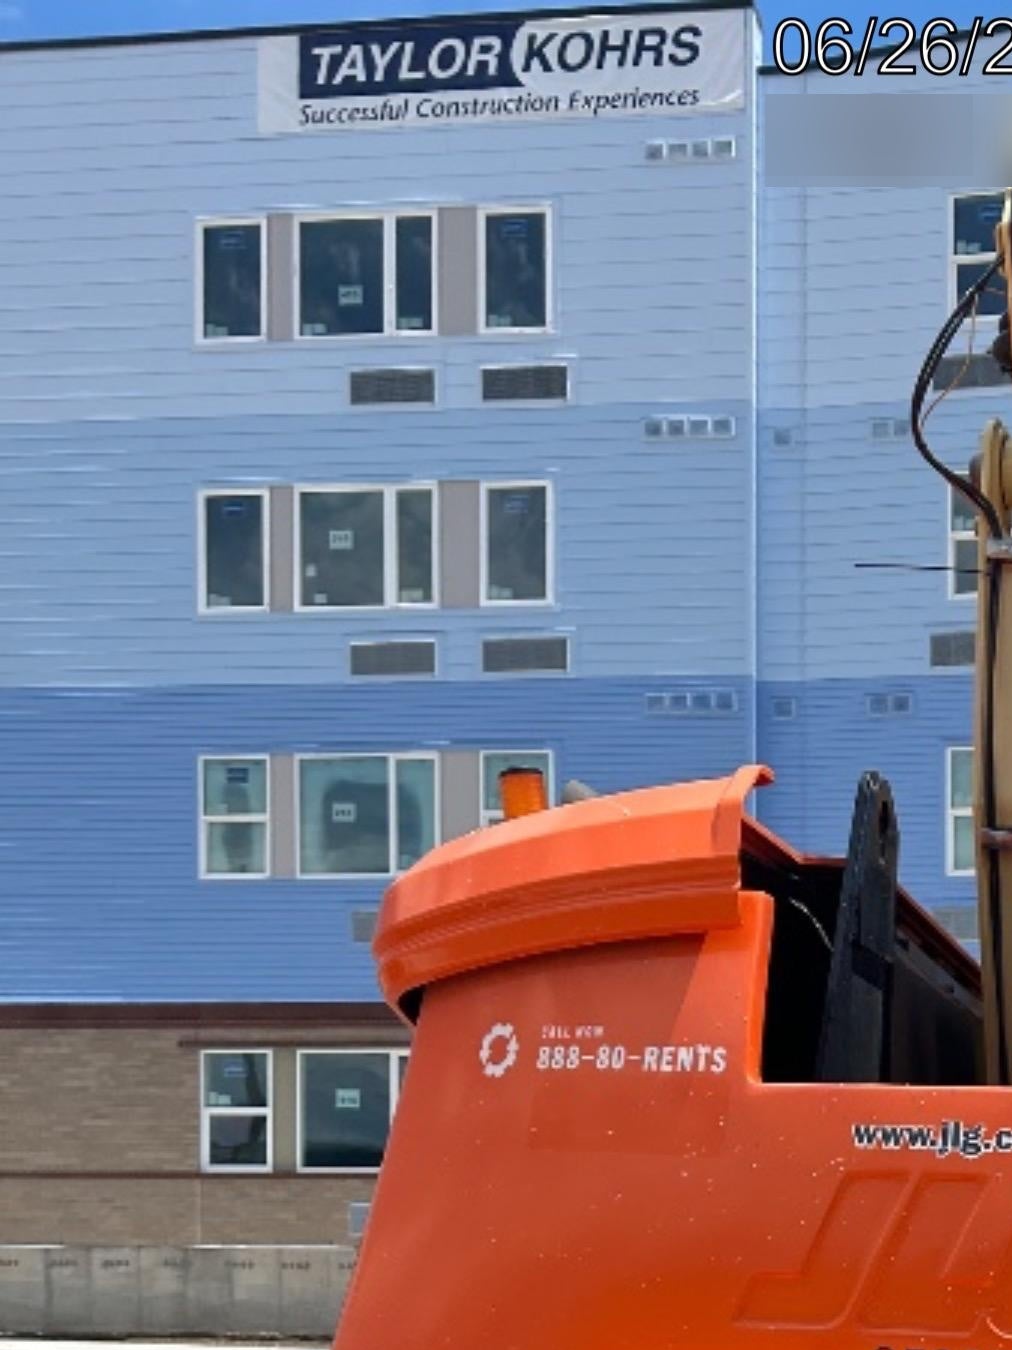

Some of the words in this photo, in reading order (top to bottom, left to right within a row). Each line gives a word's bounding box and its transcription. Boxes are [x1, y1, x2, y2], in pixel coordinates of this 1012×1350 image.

[311, 36, 502, 86] TAYLOR
[521, 24, 703, 74] KOHRS
[299, 98, 408, 127] Successful
[415, 91, 560, 119] Construction
[567, 86, 701, 117] Experiences
[536, 1044, 728, 1073] 888-80-RENTS
